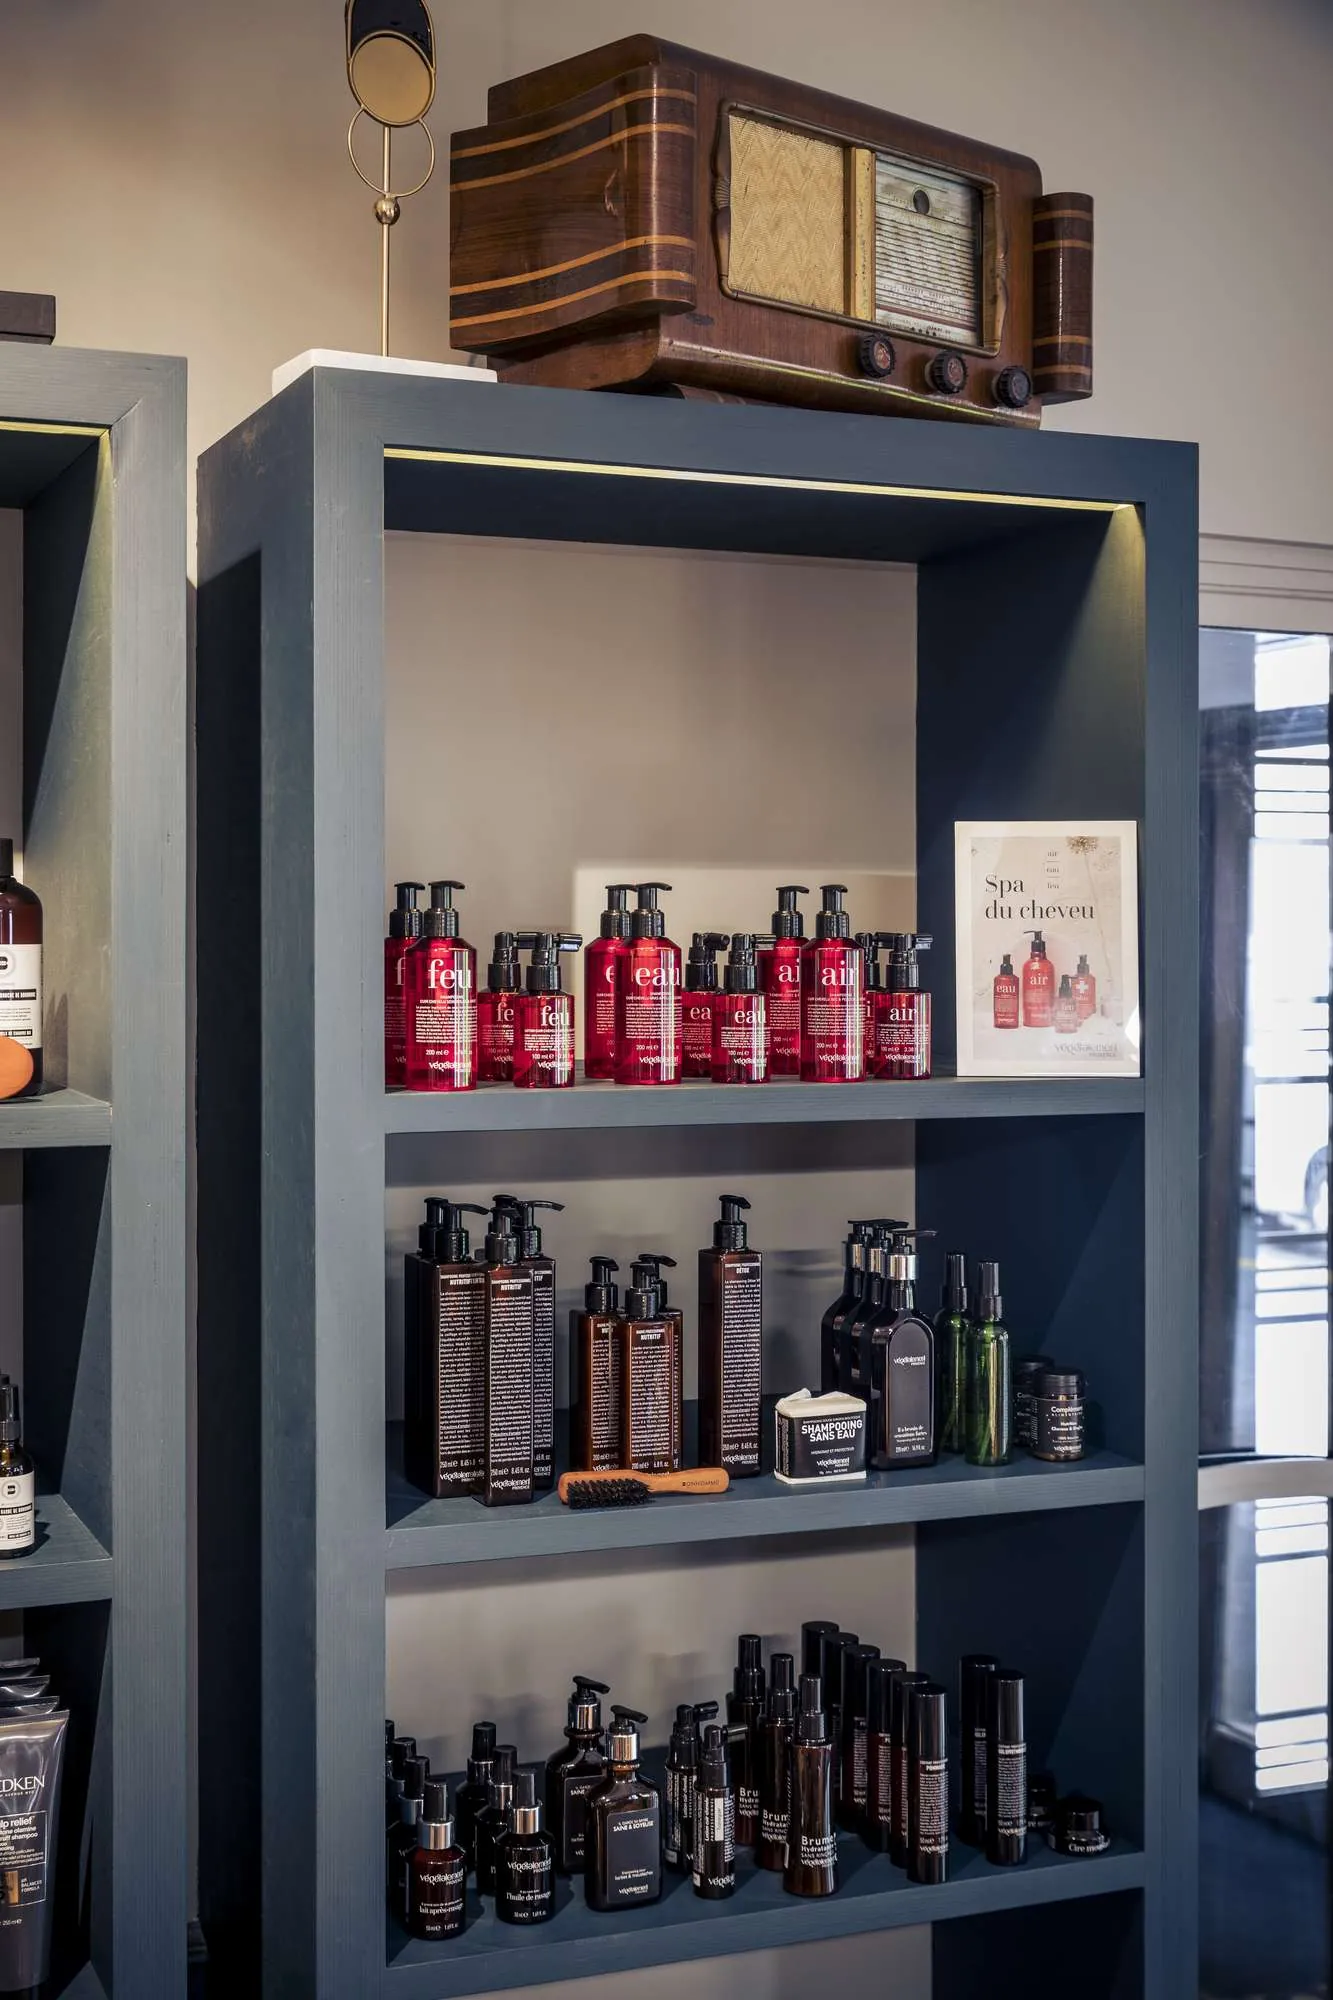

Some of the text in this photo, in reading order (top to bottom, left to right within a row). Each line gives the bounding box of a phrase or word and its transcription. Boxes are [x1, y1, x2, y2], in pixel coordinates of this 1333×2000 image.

[985, 874, 1025, 899] Spa
[985, 899, 1095, 919] du cheveu
[428, 958, 473, 989] feu
[635, 966, 681, 987] eau
[821, 960, 858, 986] air
[996, 984, 1016, 993] eau
[541, 1005, 571, 1026] feu
[734, 1010, 767, 1024] eau
[890, 1003, 917, 1021] air
[801, 1419, 863, 1435] SHAMPOOING
[809, 1429, 856, 1442] SANS EAU
[11, 1816, 33, 1828] relief
[11, 1832, 39, 1841] shampoo
[801, 1835, 834, 1846] Brume
[525, 1893, 534, 1901] de
